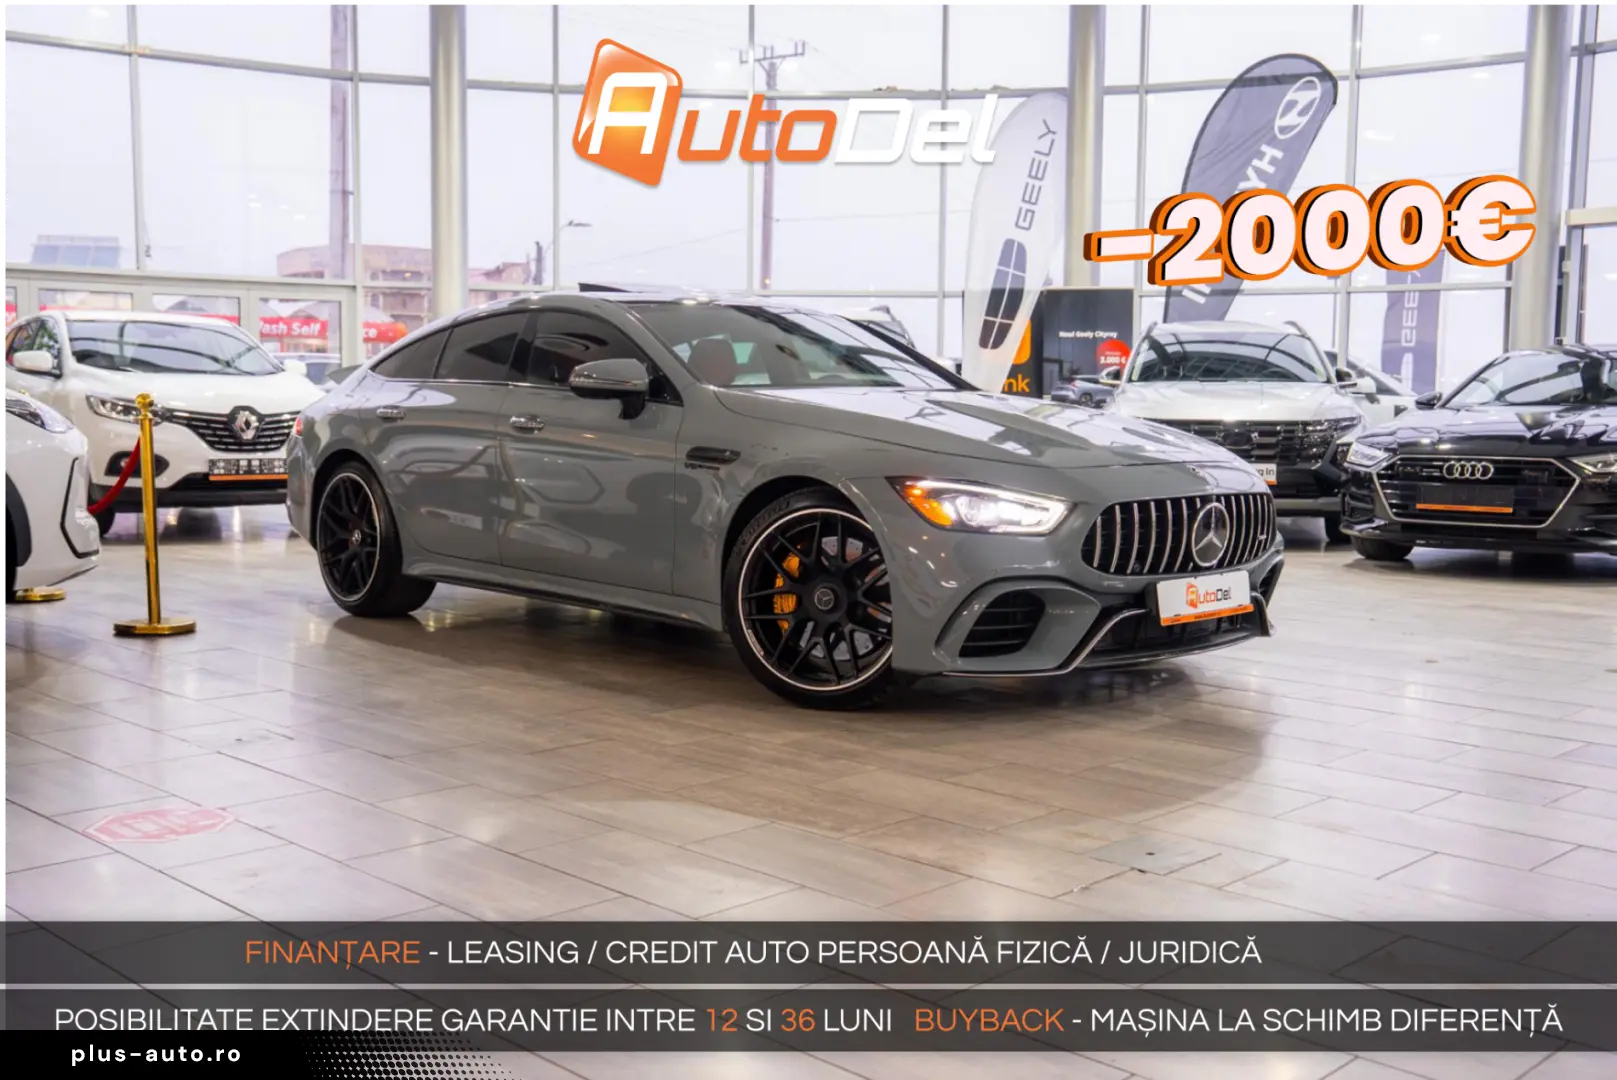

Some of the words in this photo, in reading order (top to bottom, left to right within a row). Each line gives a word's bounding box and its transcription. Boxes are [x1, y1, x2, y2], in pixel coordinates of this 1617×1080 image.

[1014, 118, 1058, 231] GEELY
[291, 322, 321, 335] Self
[1187, 584, 1232, 608] AutoDel
